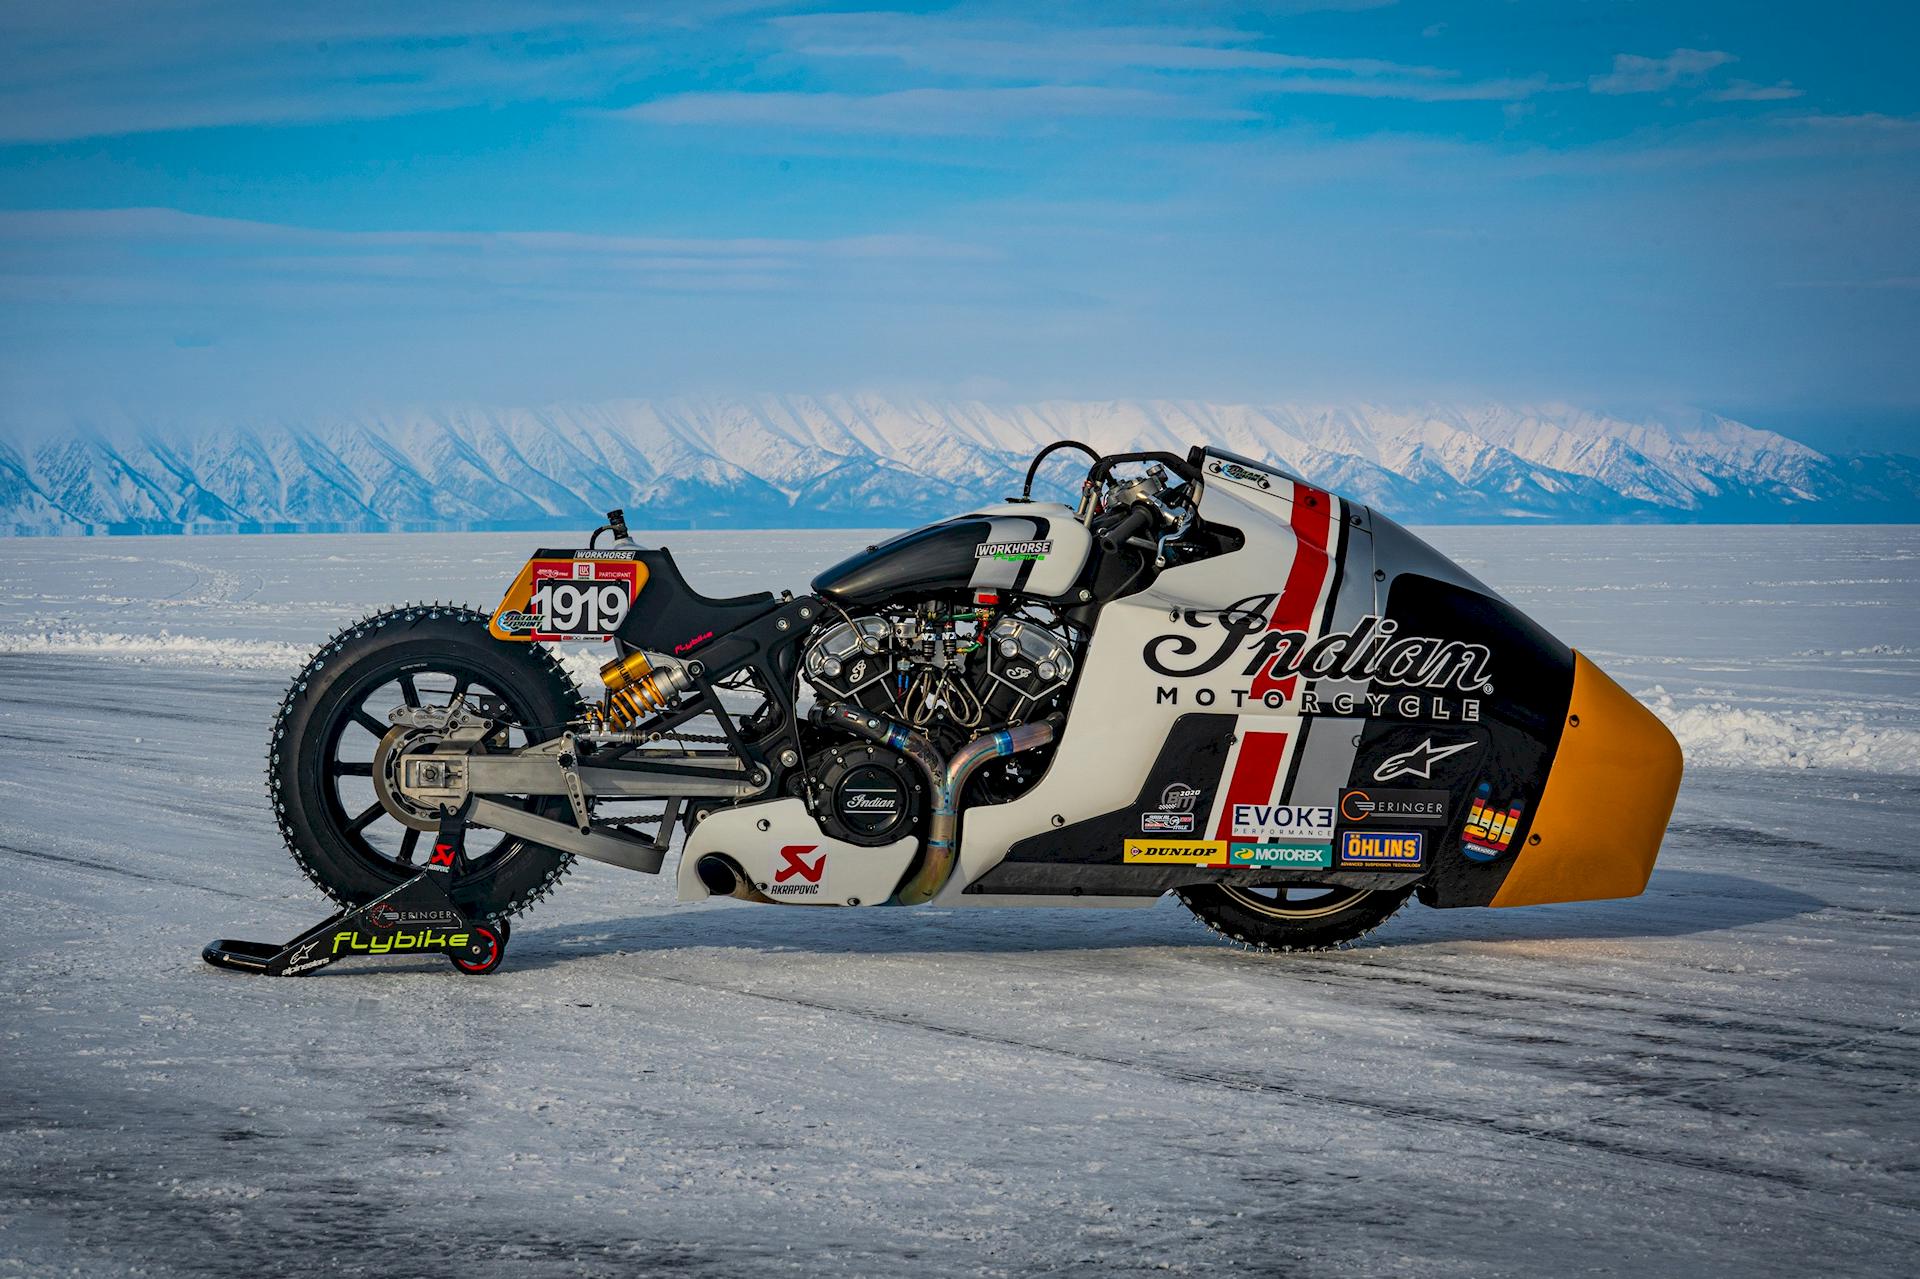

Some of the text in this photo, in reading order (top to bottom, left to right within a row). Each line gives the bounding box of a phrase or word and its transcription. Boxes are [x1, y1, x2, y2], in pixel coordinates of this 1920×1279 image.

[576, 551, 633, 560] WORKHORSE
[979, 542, 1050, 556] WORKHORSE
[531, 585, 628, 631] 1919
[1143, 590, 1494, 692] Indian
[1156, 686, 1481, 722] MOTORCYCLE
[847, 794, 896, 808] Indian
[1233, 828, 1333, 837] PERFORMANCE
[1144, 847, 1218, 857] DUNLOP
[1348, 834, 1416, 858] ÖHLINS
[1255, 848, 1323, 862] MOTOREX
